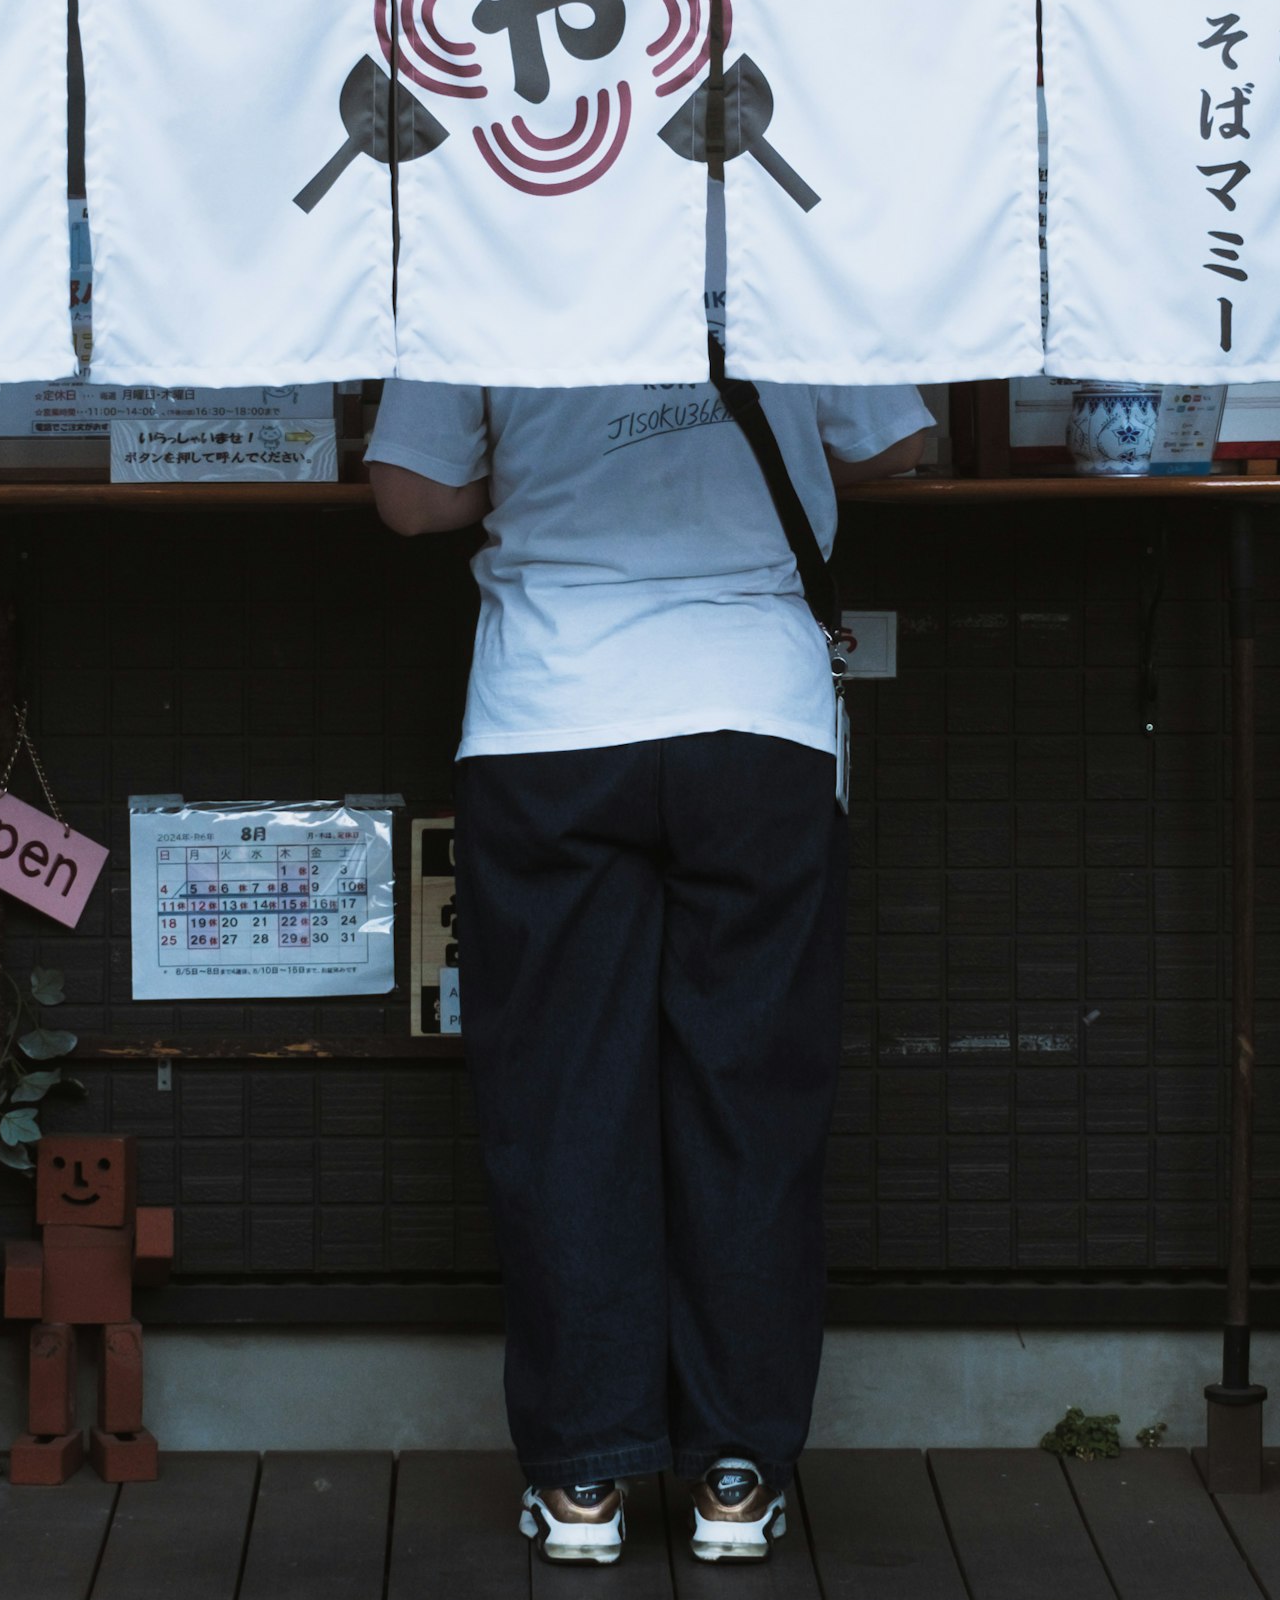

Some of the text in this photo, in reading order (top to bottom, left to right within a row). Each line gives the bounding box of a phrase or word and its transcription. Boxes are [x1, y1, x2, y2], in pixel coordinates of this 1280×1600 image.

[139, 432, 253, 444] いらっしゃいませ！
[241, 827, 265, 841] 8月
[161, 851, 170, 860] 日
[190, 849, 199, 859] 月
[221, 849, 231, 859] 火
[251, 849, 262, 859] 水
[280, 849, 291, 859] 木
[311, 848, 322, 858] 金
[721, 1474, 742, 1485] NIKE
